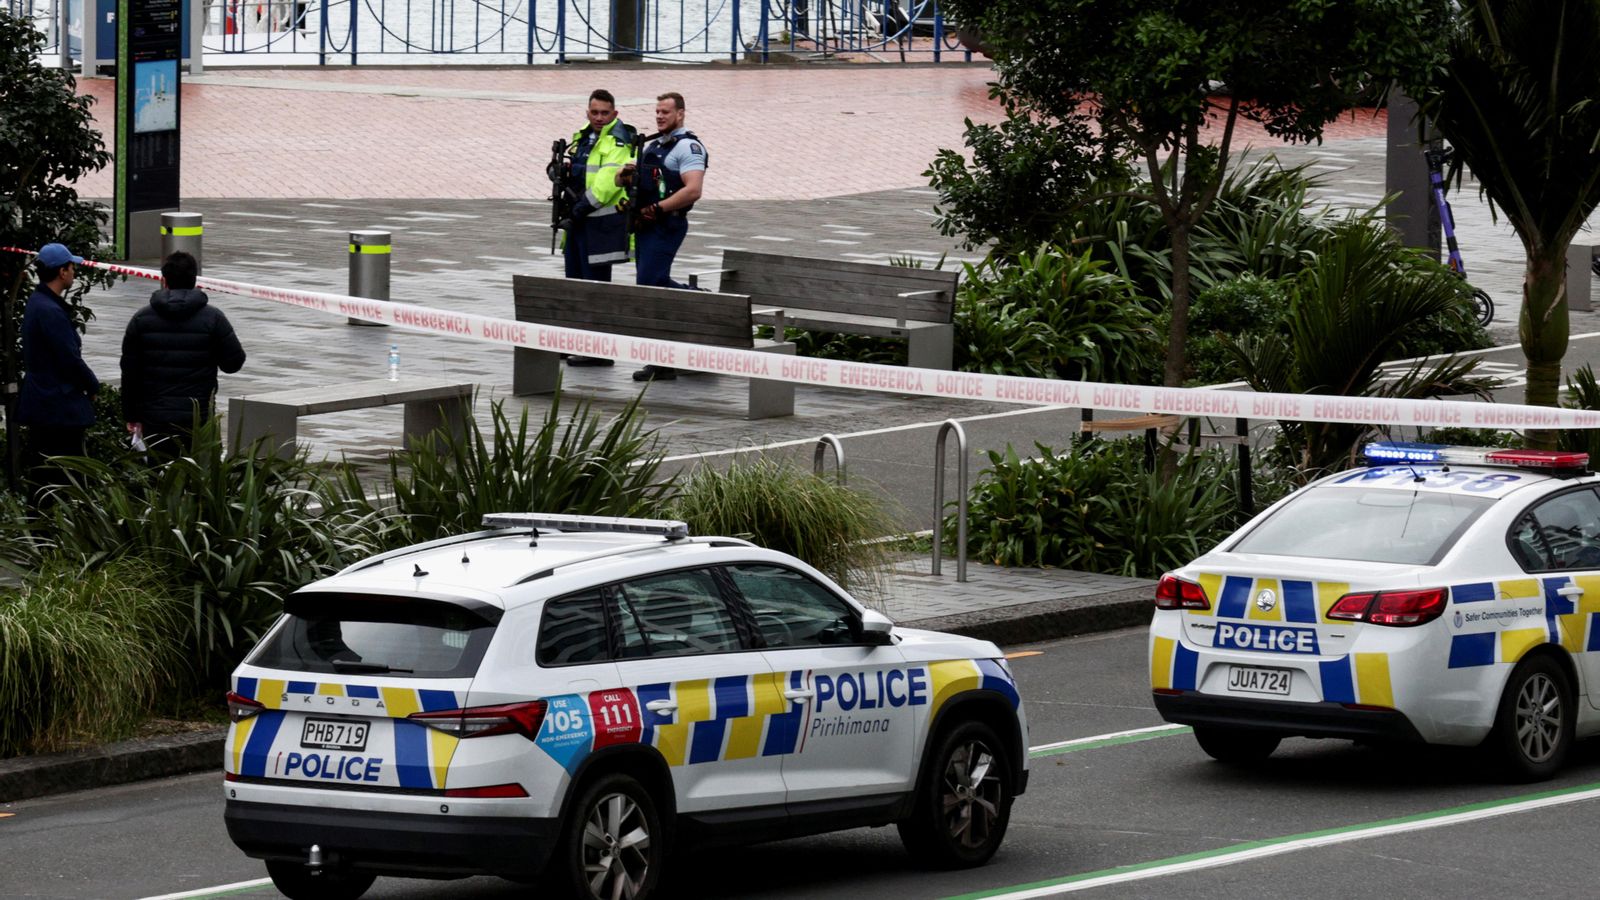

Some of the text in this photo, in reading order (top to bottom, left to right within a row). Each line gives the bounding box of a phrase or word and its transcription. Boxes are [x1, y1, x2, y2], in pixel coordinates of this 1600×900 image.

[1465, 606, 1543, 622] Safer Communities Together
[1218, 624, 1314, 652] POLICE
[814, 668, 927, 713] POLICE
[1230, 670, 1288, 691] JUA724
[553, 700, 567, 708] USE
[603, 694, 621, 703] CALL
[545, 710, 583, 734] 105
[600, 703, 632, 725] 111
[305, 723, 365, 744] PHB719
[811, 716, 890, 737] Pirihimana
[284, 752, 383, 782] POLICE
